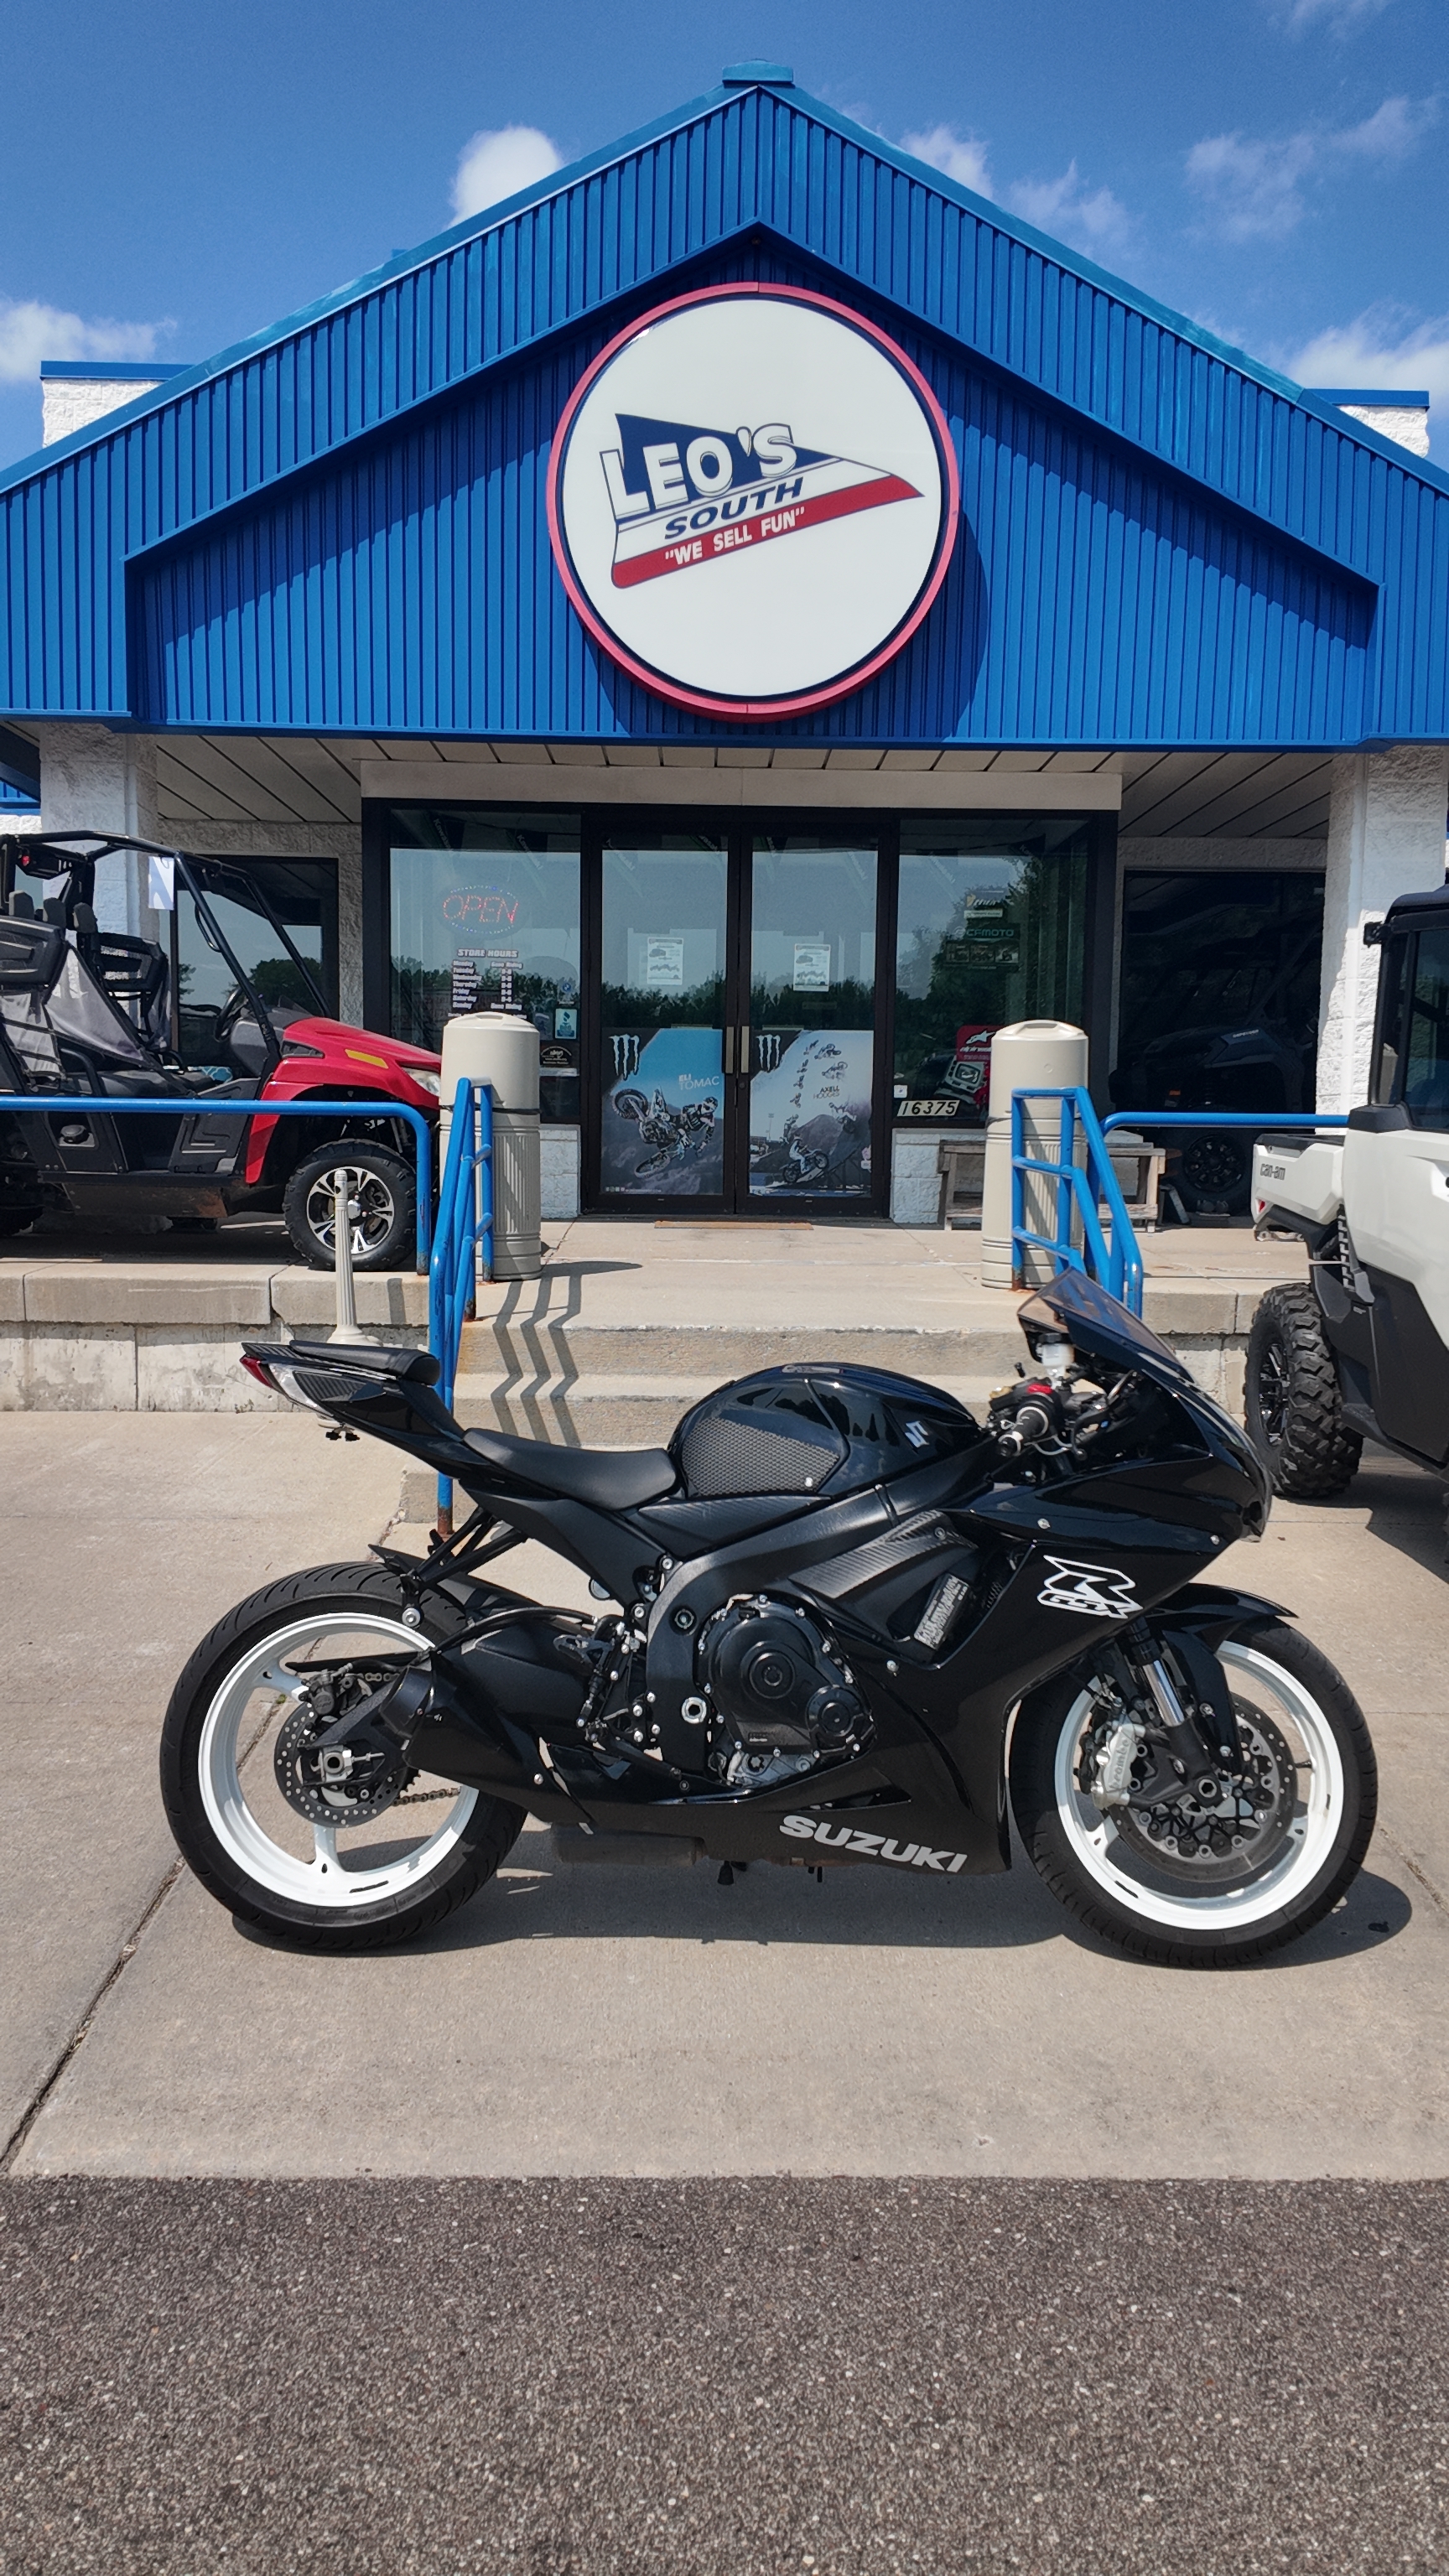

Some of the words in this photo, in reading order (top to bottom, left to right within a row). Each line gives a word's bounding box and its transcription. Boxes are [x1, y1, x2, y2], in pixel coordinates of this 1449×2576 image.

[600, 423, 797, 520] LEO'S
[664, 476, 804, 540] SOUTH
[714, 525, 752, 552] SELL
[443, 895, 520, 925] OPEN
[966, 928, 1015, 937] CFMOTO
[457, 948, 486, 957] STORE
[679, 1073, 692, 1082] ELI
[680, 1076, 720, 1090] TOMAC
[902, 1101, 957, 1115] 16375
[779, 1815, 968, 1873] SUZUKI
